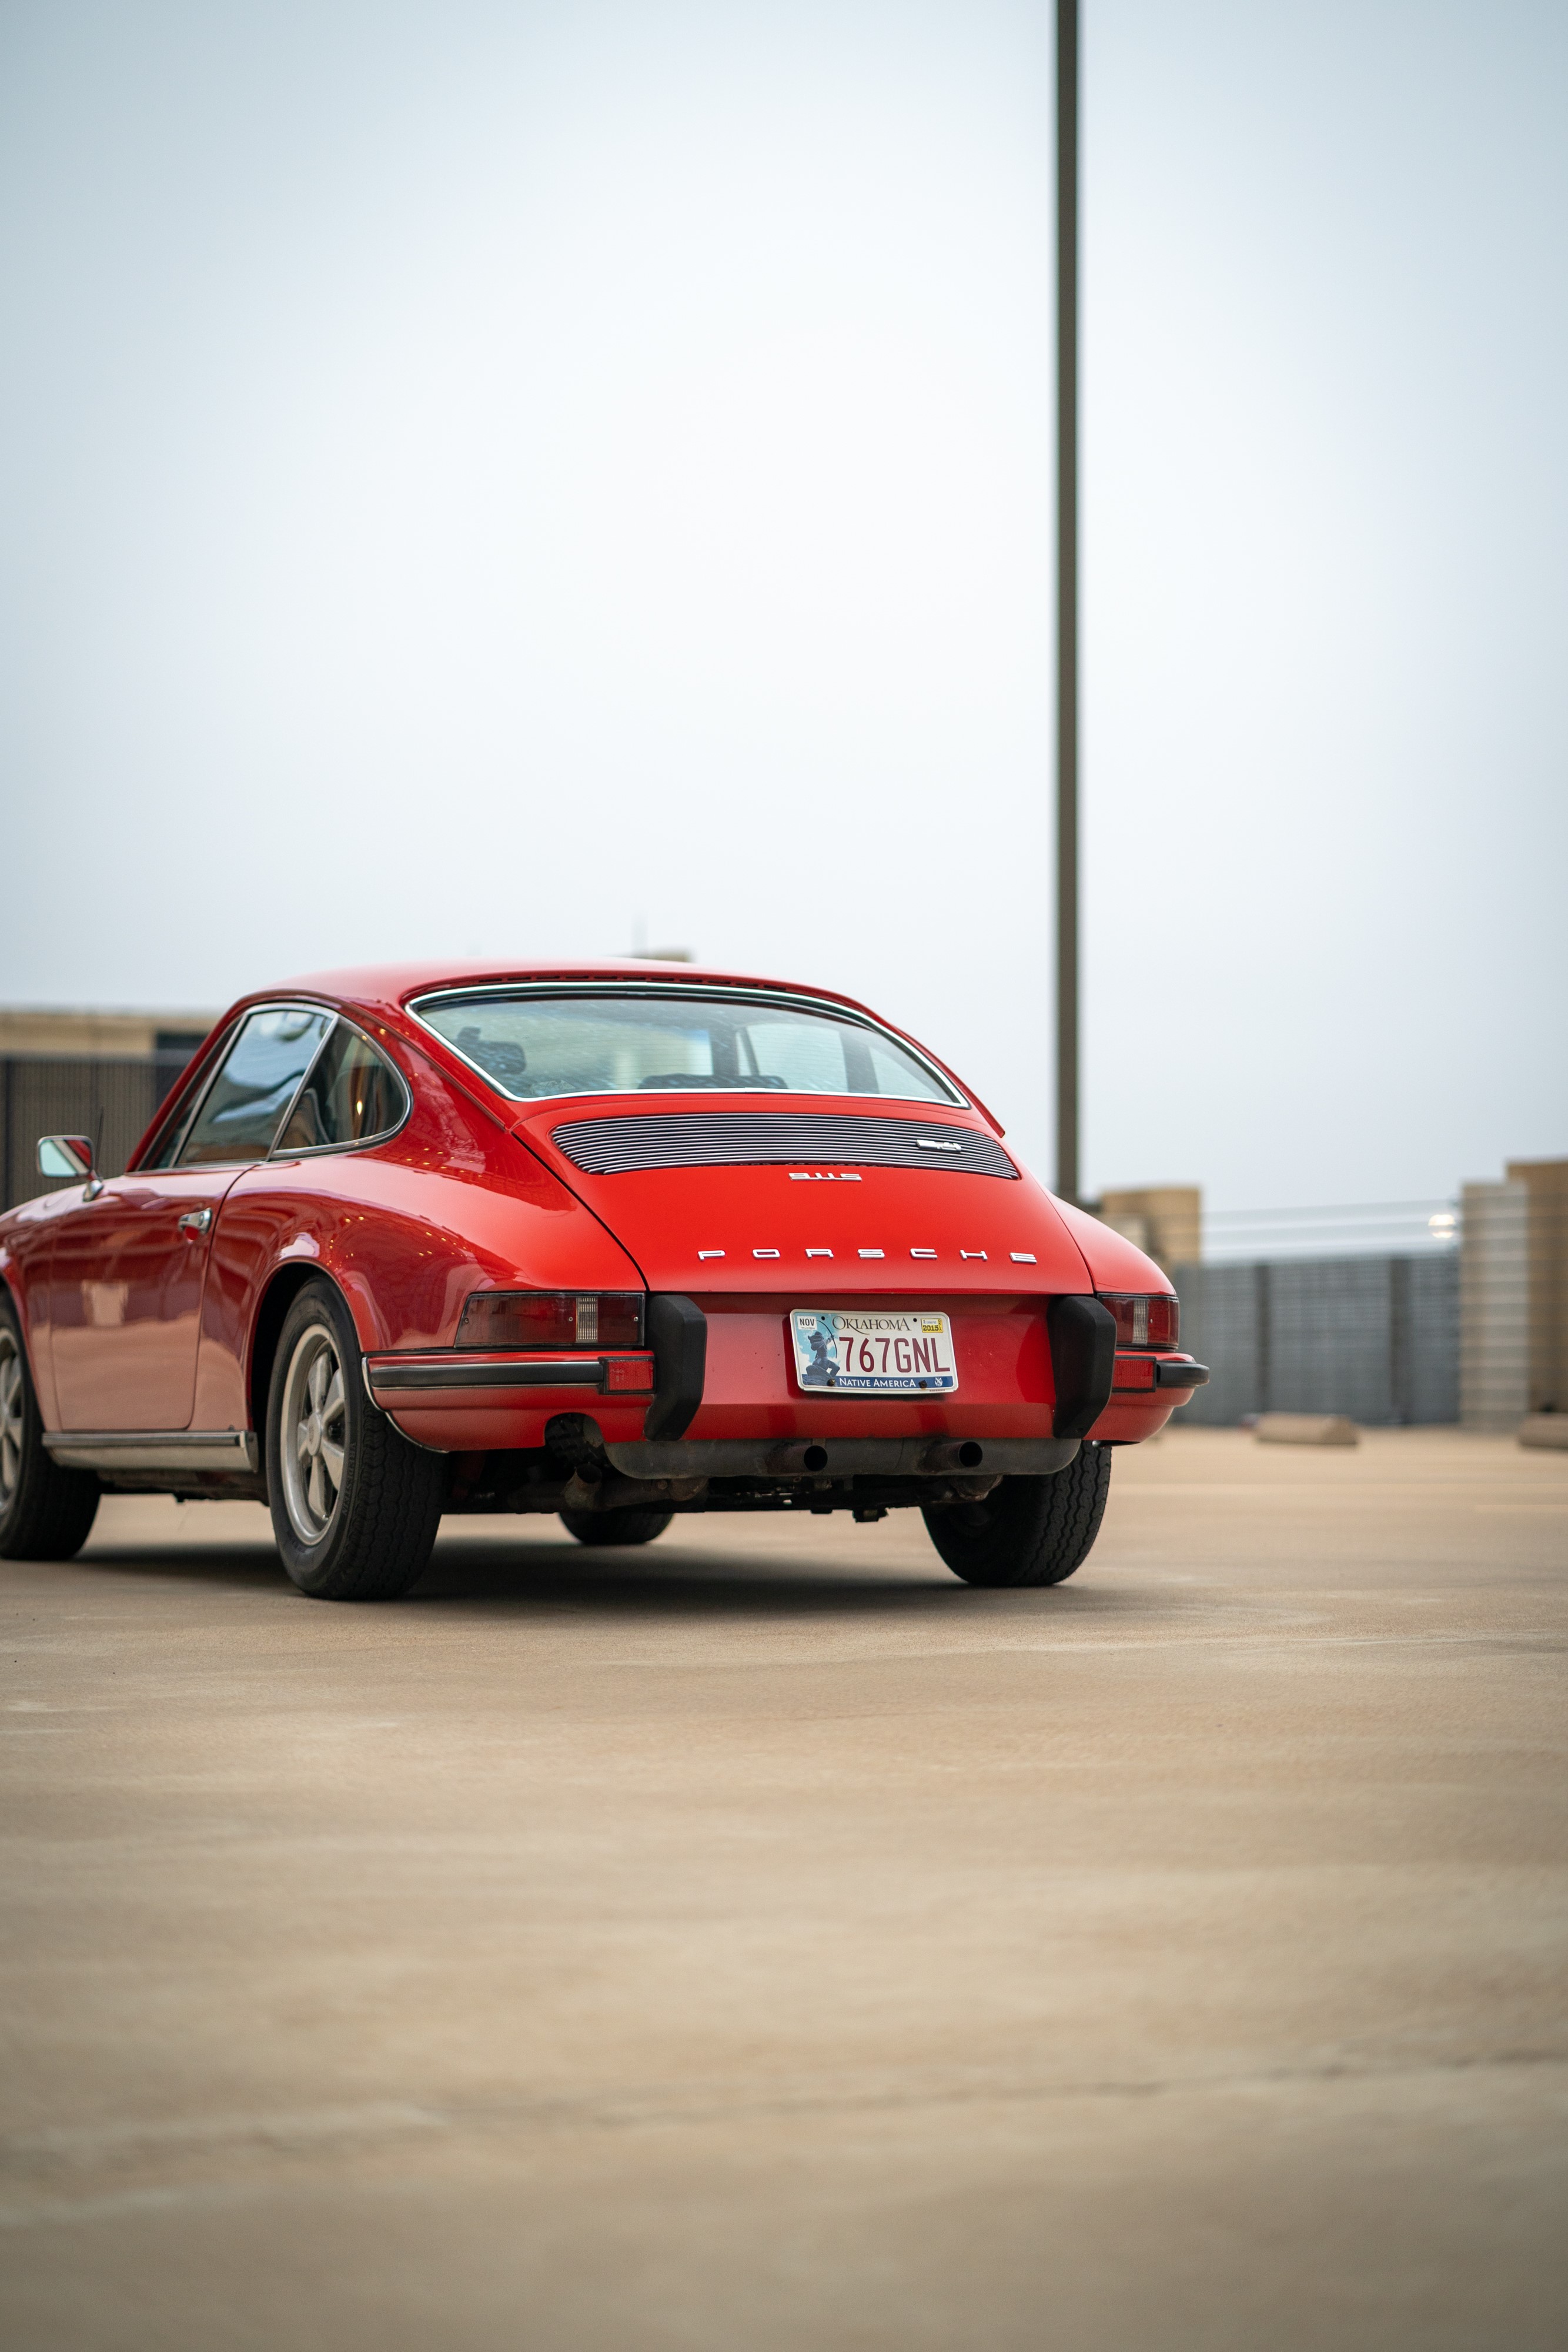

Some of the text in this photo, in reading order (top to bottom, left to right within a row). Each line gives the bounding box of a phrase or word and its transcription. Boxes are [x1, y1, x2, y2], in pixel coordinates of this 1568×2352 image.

[788, 1172, 862, 1181] 911S
[697, 1248, 1038, 1265] PORSCHE
[832, 1316, 911, 1335] OKLAHOMA
[839, 1337, 950, 1373] 767GNL
[839, 1378, 916, 1388] NATIVE AMERICA
[342, 1442, 355, 1516] VREDESTEIN
